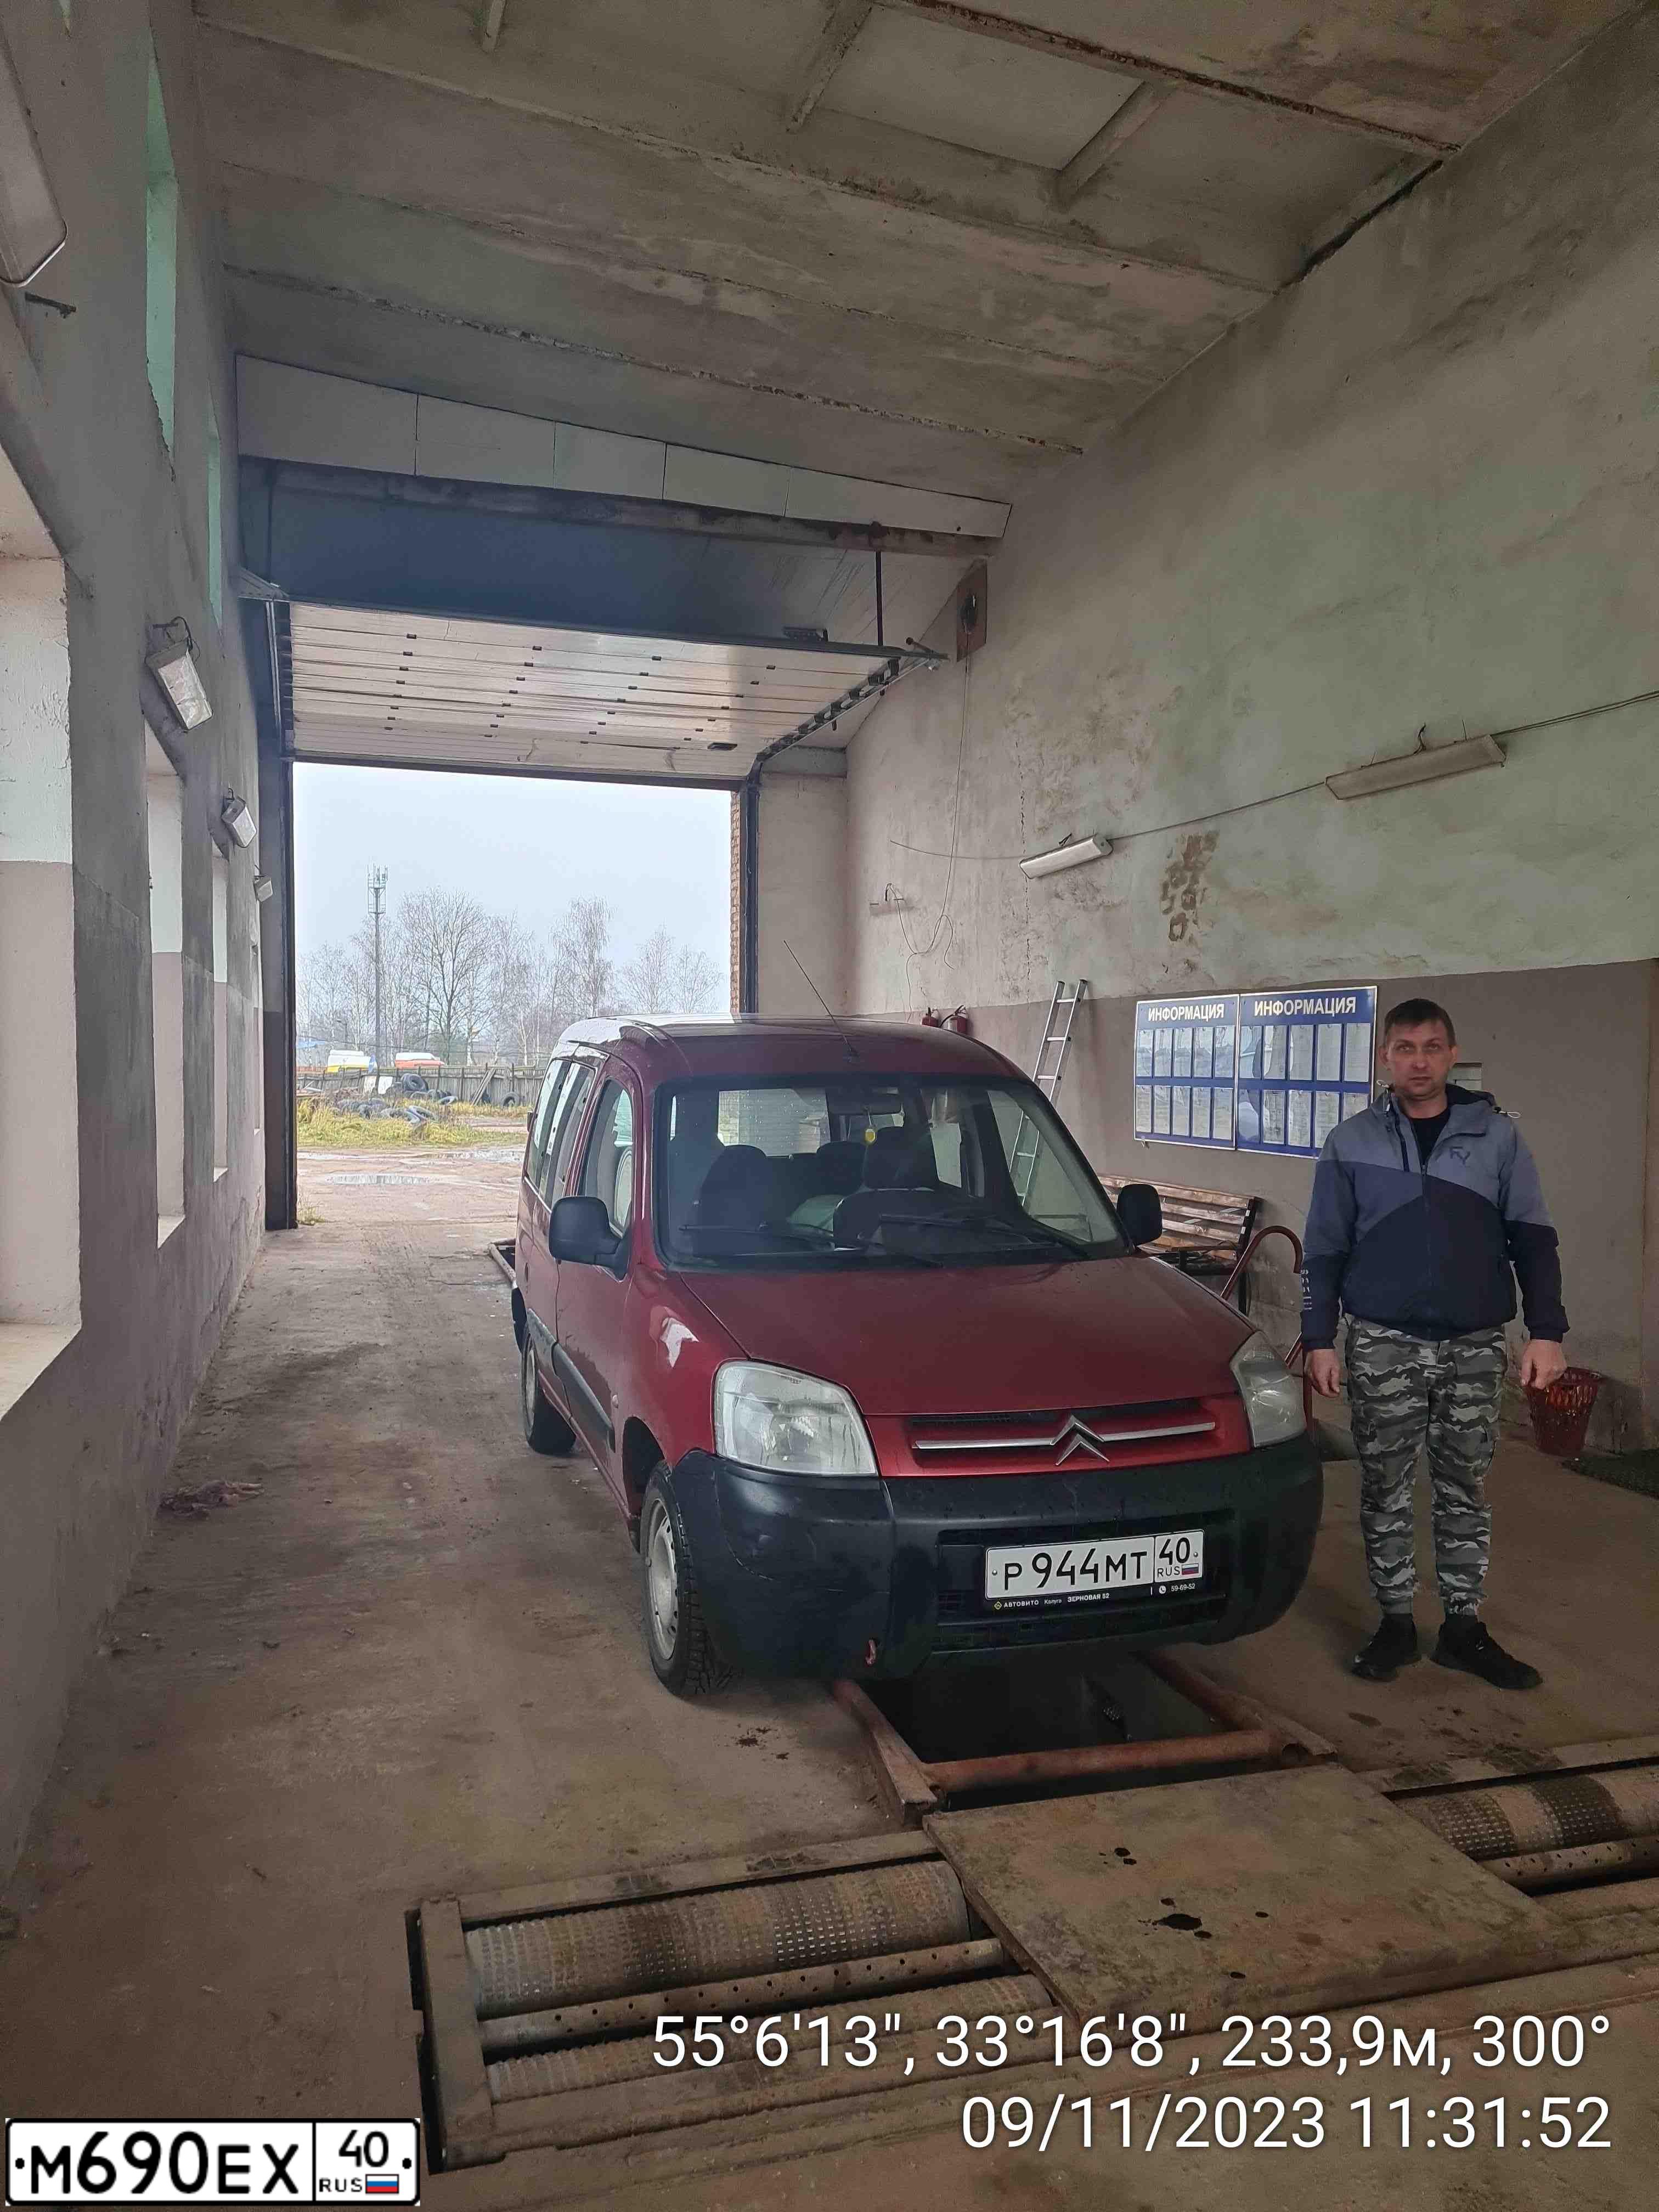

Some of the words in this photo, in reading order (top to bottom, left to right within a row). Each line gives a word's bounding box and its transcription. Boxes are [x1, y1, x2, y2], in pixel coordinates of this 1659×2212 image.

[1148, 1003, 1224, 1022] ИНФОРМАЦИЯ
[1254, 997, 1356, 1017] ИНФОРМАЦИЯ
[1159, 1537, 1190, 1566] 40
[1157, 1566, 1180, 1578] RUS
[1004, 1600, 1039, 1608] АВТОВИТО
[1068, 1594, 1101, 1602] ЗЕРНОВАЯ
